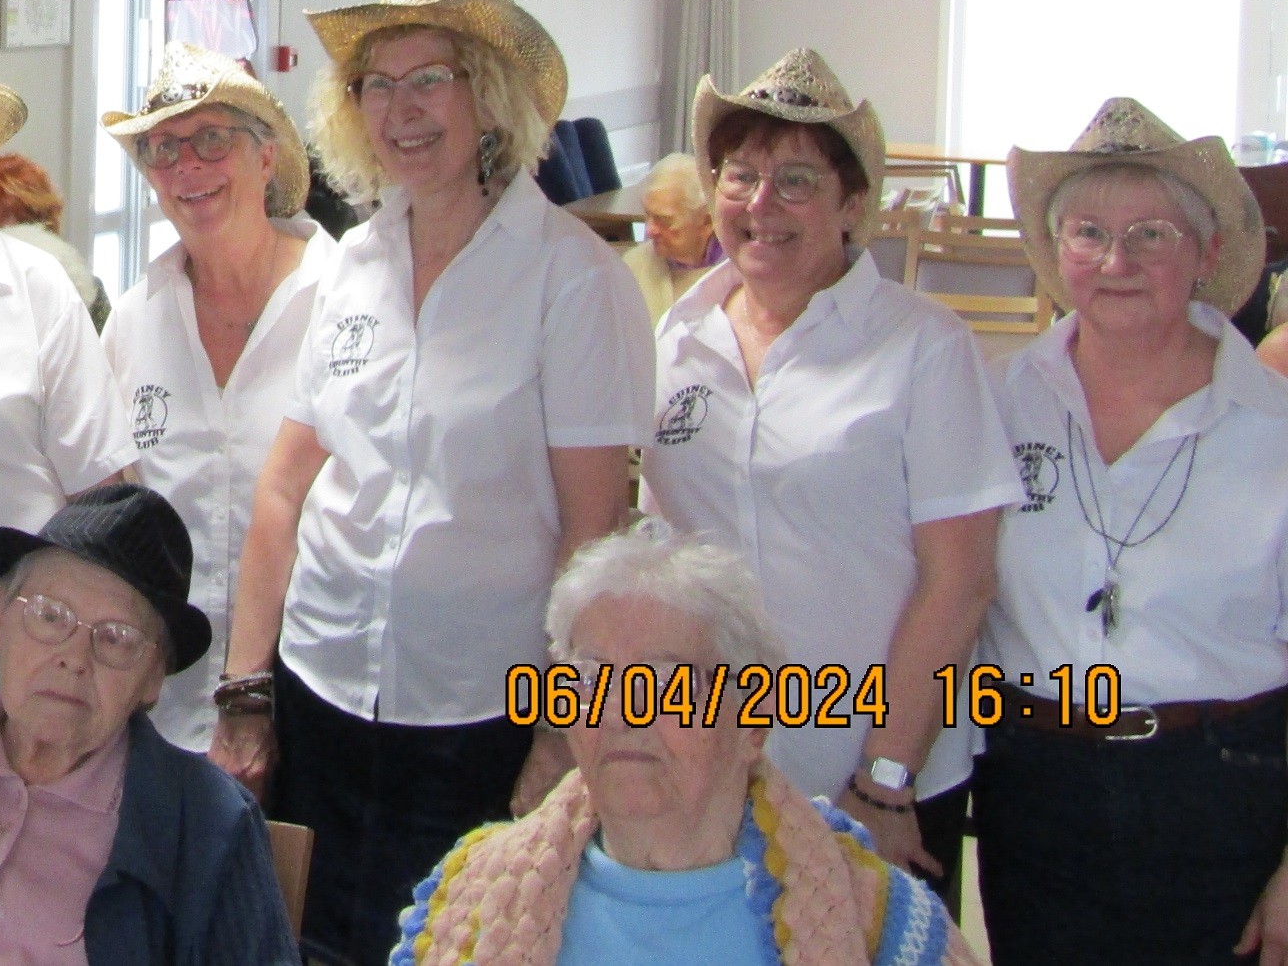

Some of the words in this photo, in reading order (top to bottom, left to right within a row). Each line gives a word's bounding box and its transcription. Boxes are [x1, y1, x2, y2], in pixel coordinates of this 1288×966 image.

[329, 359, 369, 369] COUNTRY
[333, 366, 359, 376] CLUB
[1013, 442, 1066, 460] UINCY
